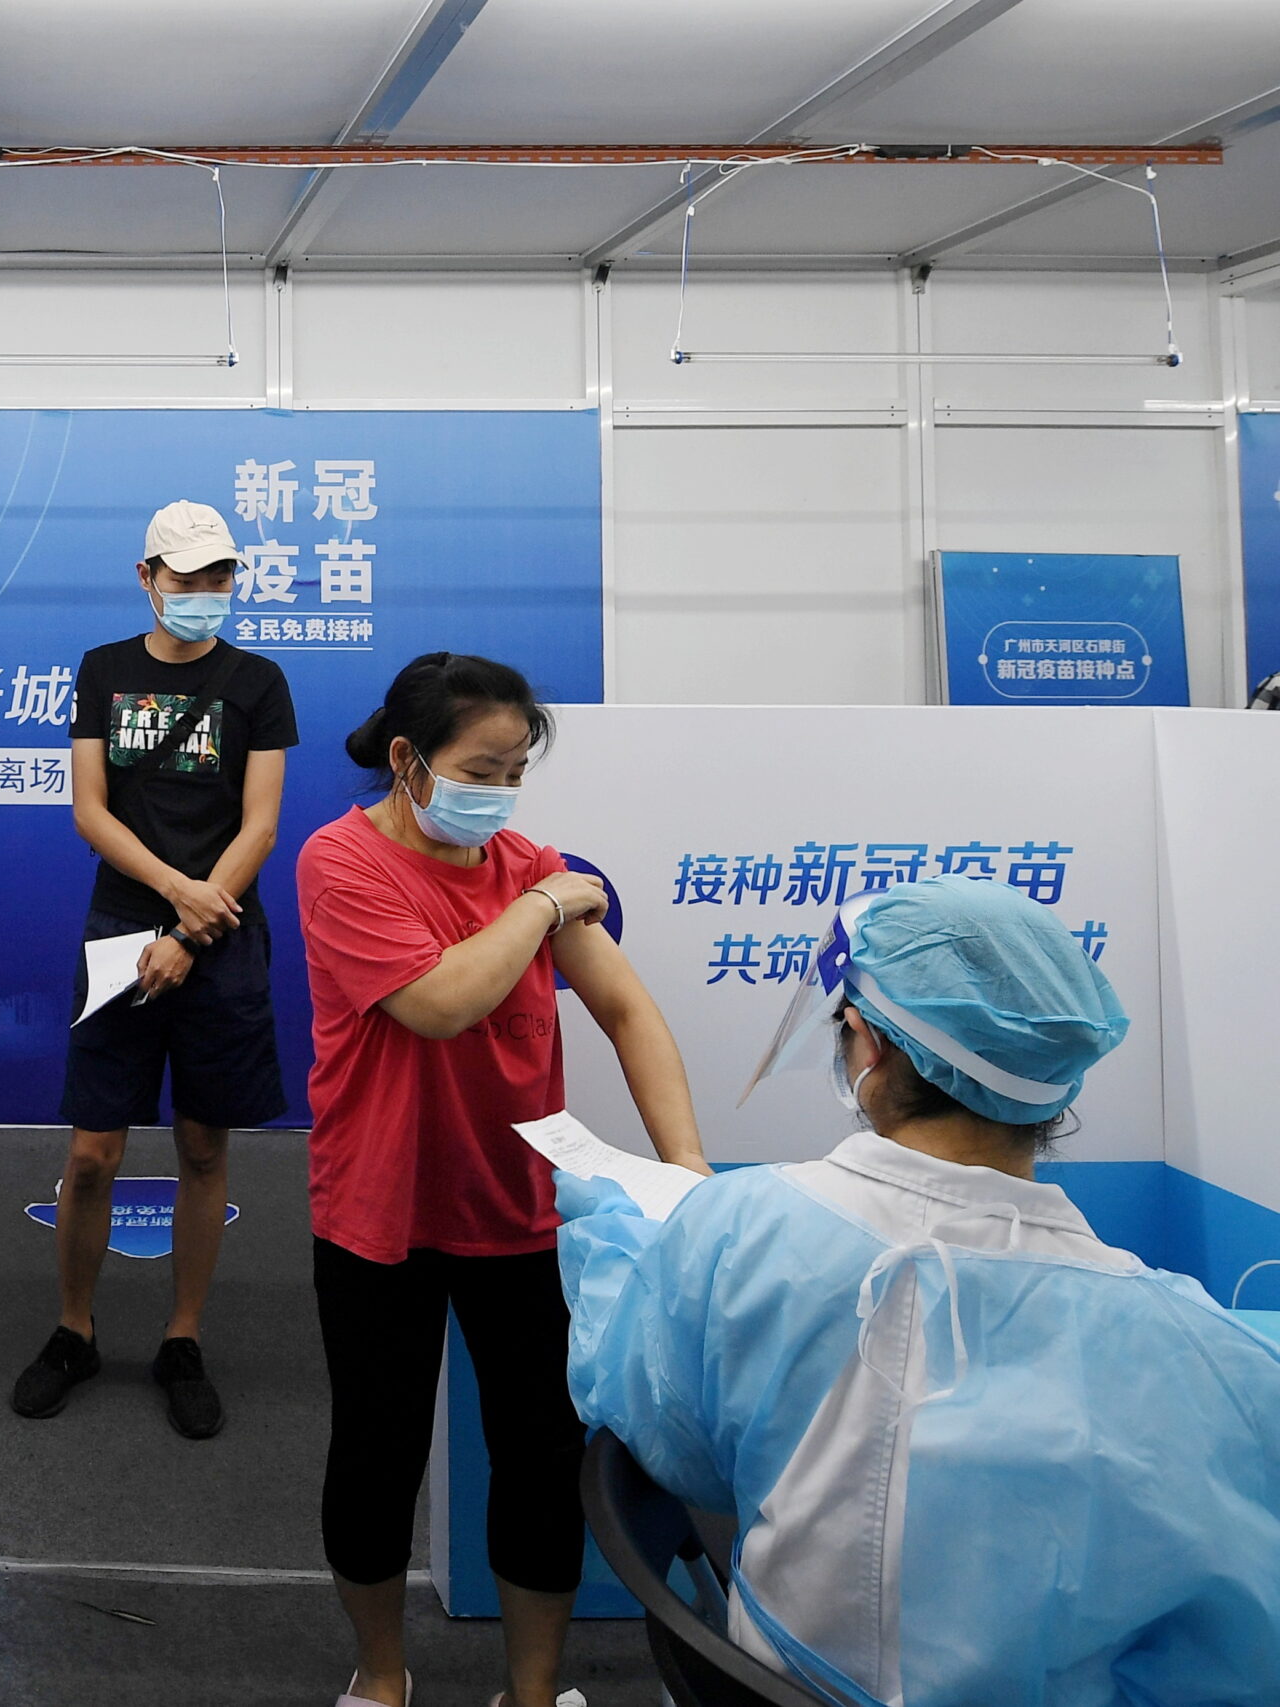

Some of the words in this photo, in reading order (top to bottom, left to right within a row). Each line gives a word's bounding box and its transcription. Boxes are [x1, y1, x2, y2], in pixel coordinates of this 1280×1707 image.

[234, 458, 378, 523] 新冠
[234, 538, 377, 604] 疫苗
[235, 618, 373, 642] 全民免费接种
[1004, 638, 1126, 654] 广州市天河区石牌街
[997, 659, 1135, 681] 新冠疫苗接种点
